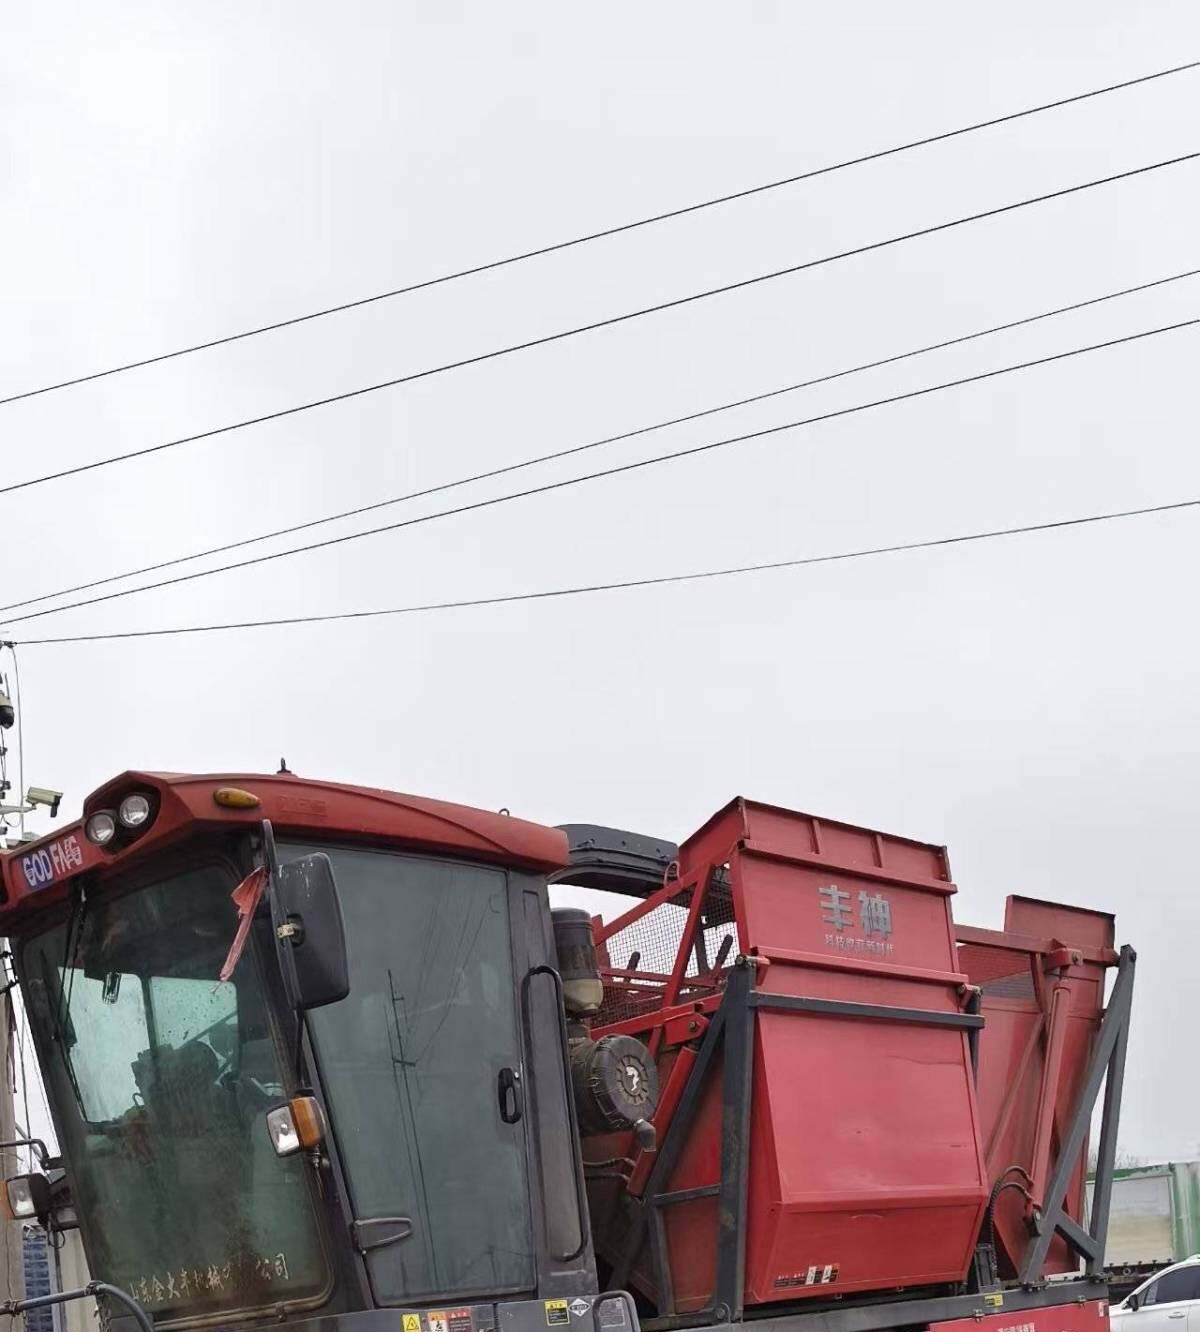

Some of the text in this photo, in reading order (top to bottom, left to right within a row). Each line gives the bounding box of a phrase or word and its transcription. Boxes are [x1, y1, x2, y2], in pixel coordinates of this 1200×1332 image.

[22, 849, 54, 887] GOD
[130, 1252, 289, 1303] 山东金大丰机械公司
